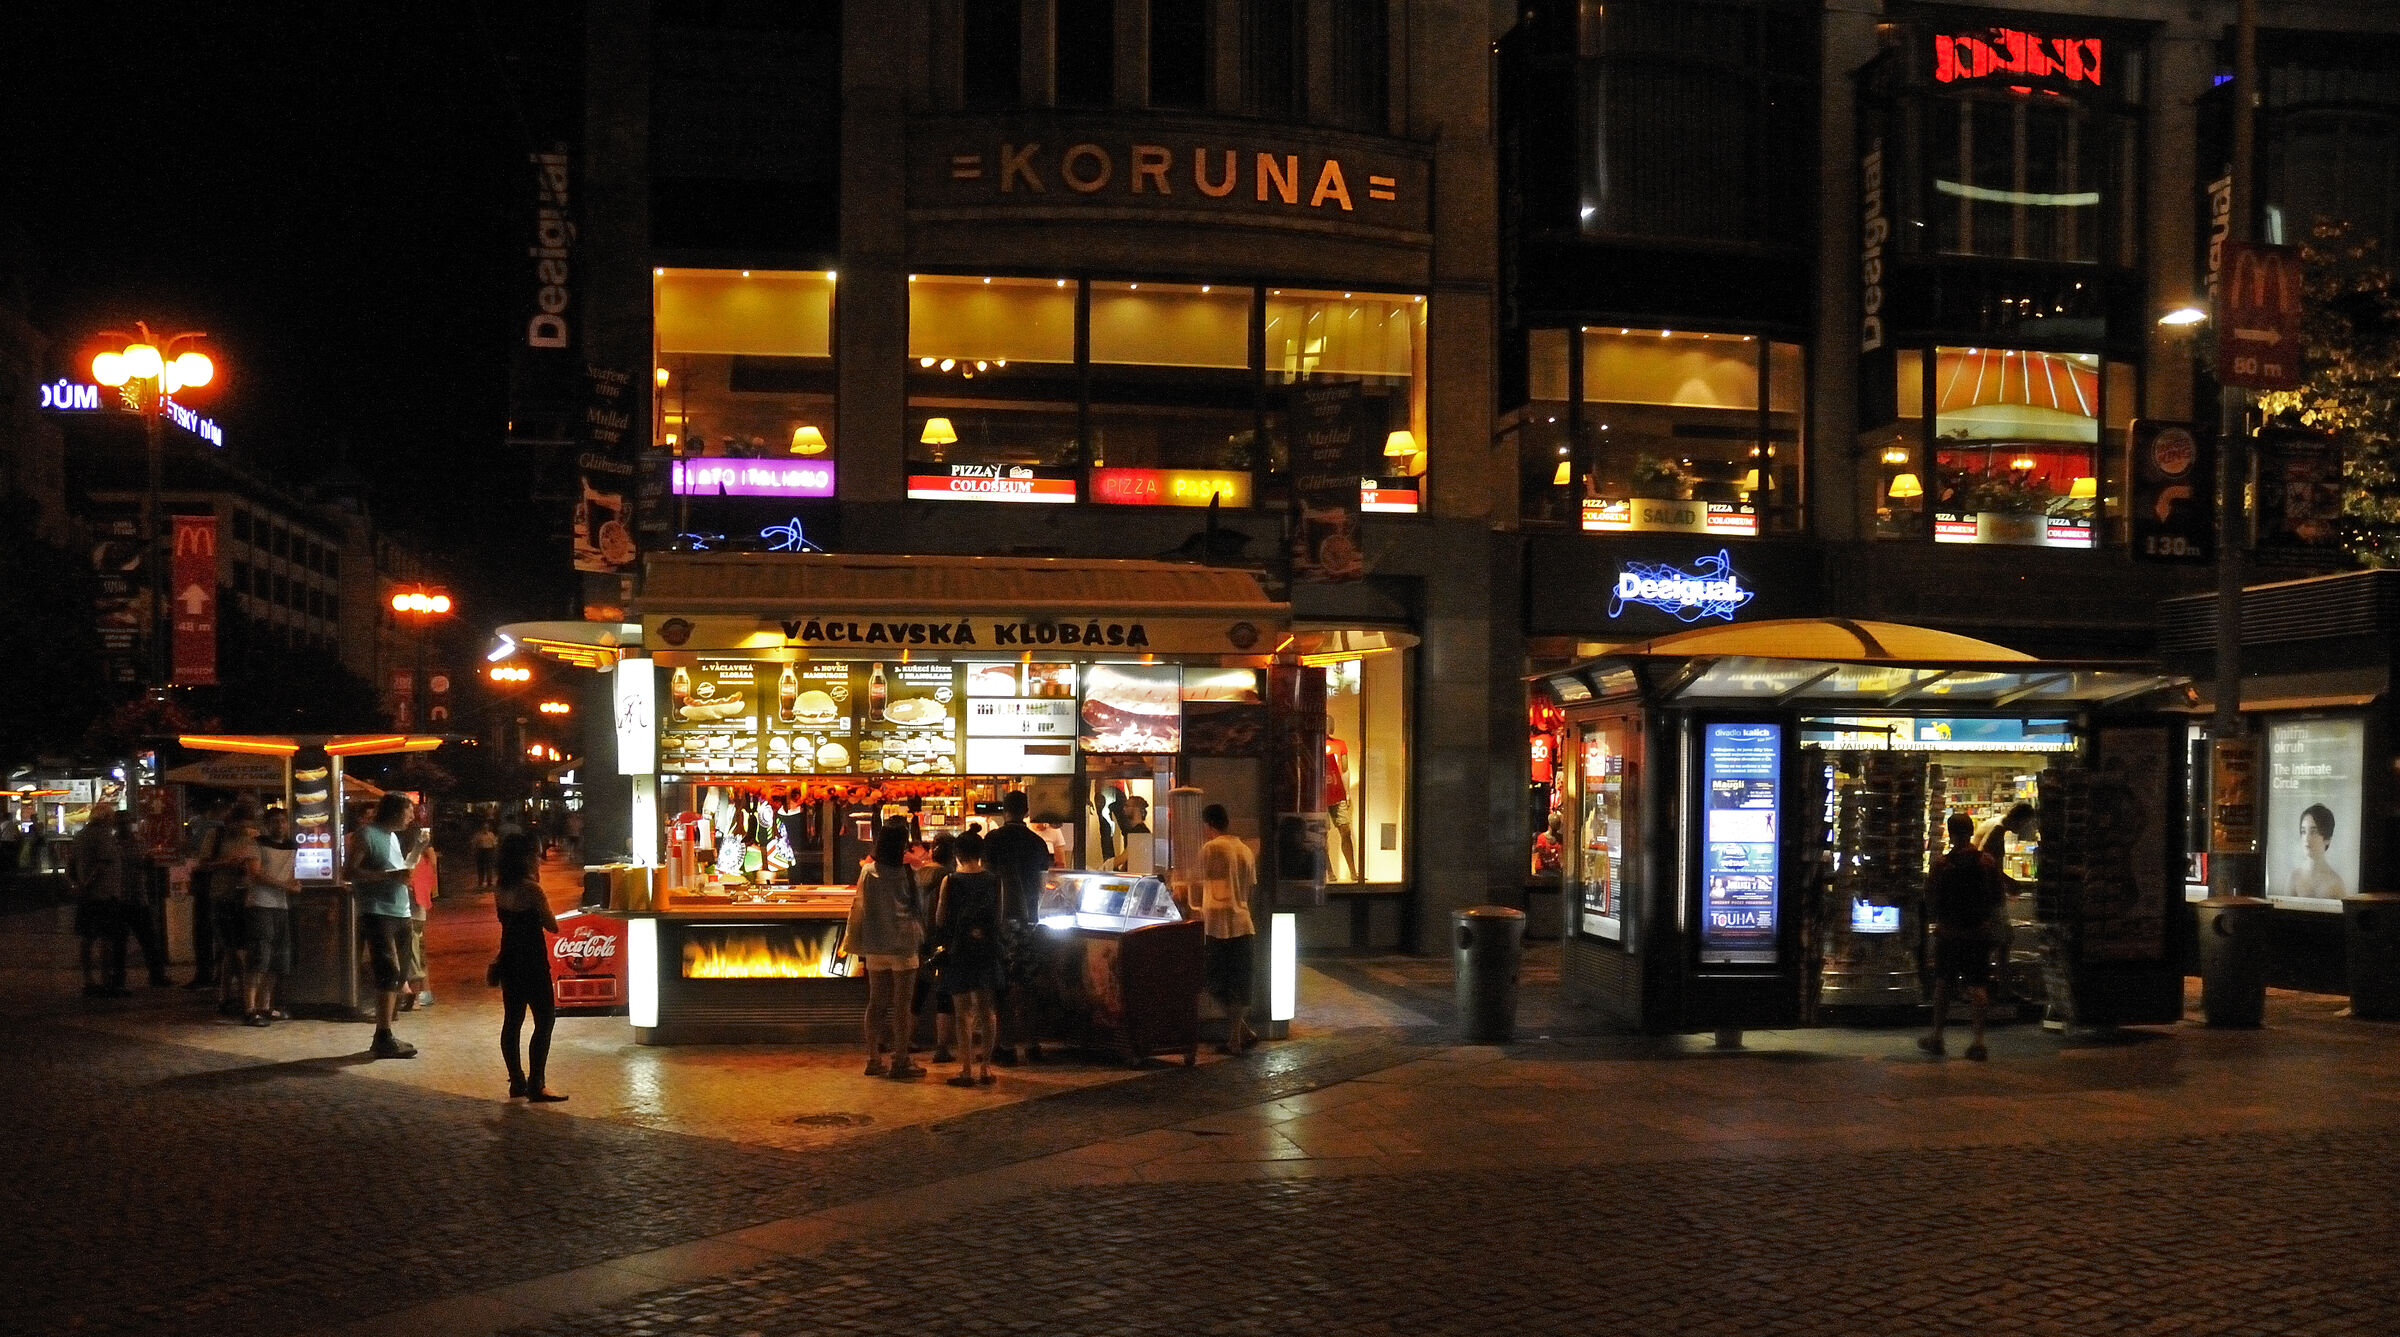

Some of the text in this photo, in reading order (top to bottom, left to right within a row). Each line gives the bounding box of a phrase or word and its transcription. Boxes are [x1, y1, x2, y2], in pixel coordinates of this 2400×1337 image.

[1001, 142, 1353, 211] KORUNA
[1862, 149, 1889, 352] Desigual
[951, 464, 994, 477] PIZZA
[950, 480, 1031, 493] COLOSEUM
[1106, 478, 1234, 497] PIZZA PASTA
[1583, 499, 1607, 508] PIZZA
[1708, 504, 1733, 513] PIZZA
[1643, 508, 1695, 524] SALAD
[2145, 536, 2186, 556] 130
[781, 617, 1149, 646] VÁCLAVSKÁ KLOBÁSA
[2274, 741, 2304, 754] okruh
[2273, 763, 2332, 775] The Intimate
[2273, 777, 2299, 789] Circle
[1710, 912, 1755, 927] TOUHA
